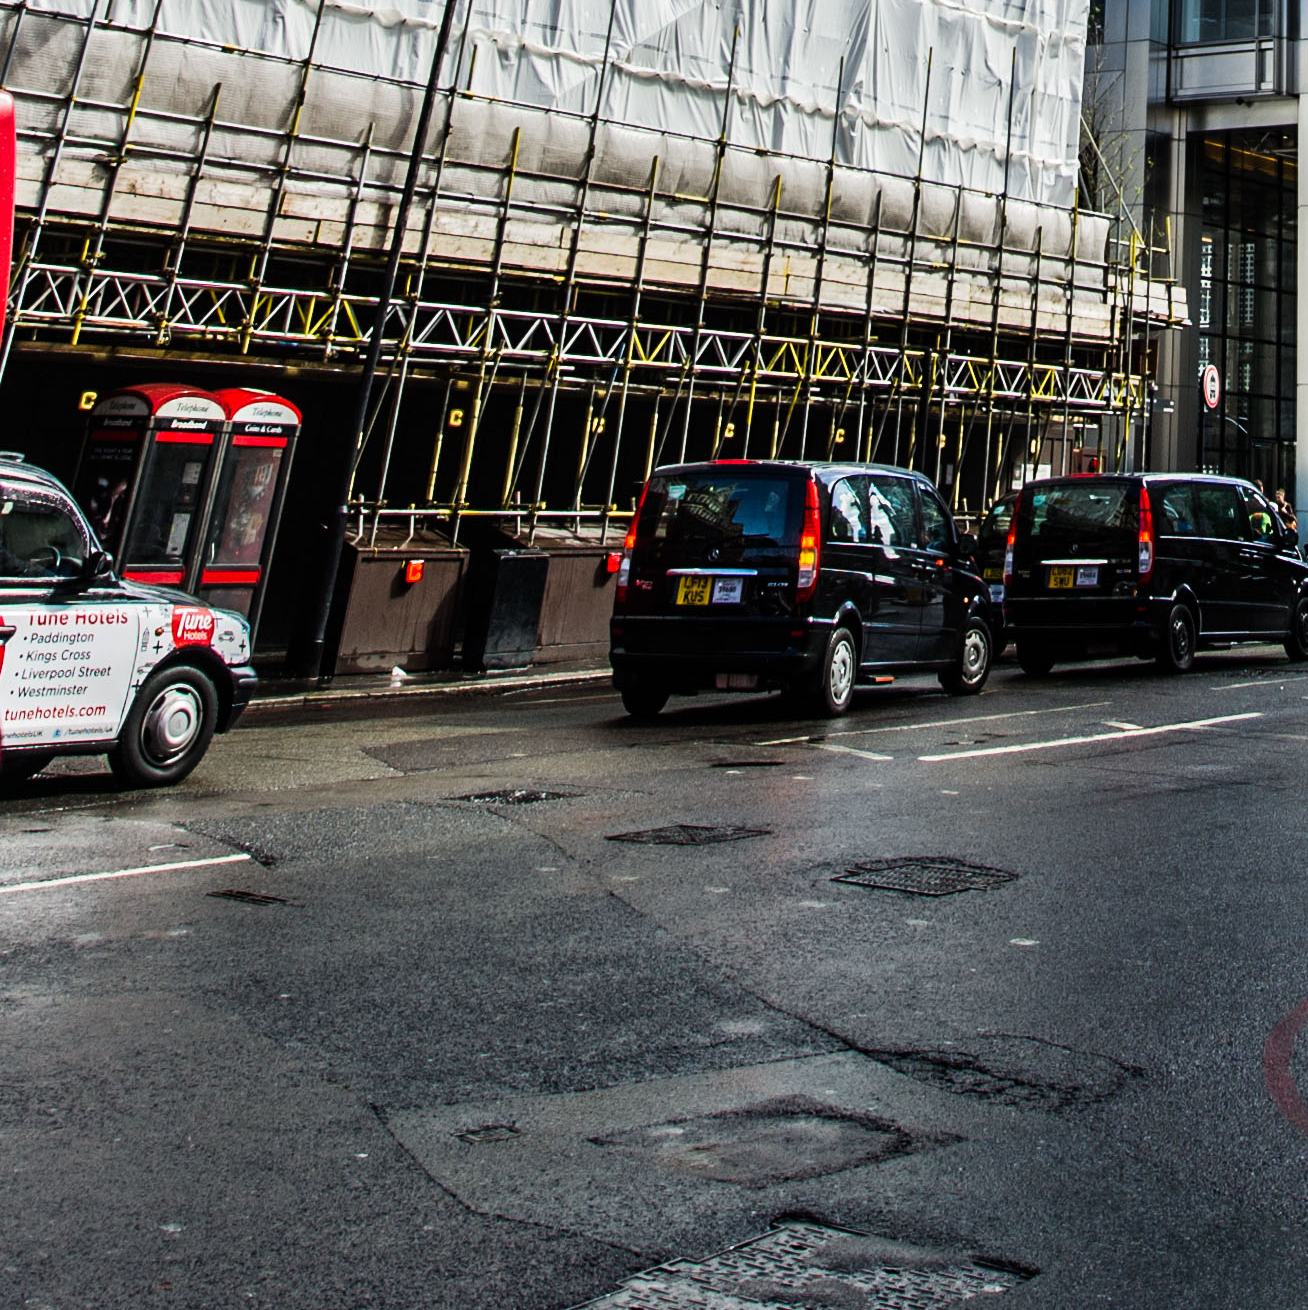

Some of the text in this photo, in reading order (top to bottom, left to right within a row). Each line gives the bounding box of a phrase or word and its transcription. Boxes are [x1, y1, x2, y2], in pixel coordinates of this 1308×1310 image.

[176, 402, 209, 414] Telephone
[252, 407, 283, 417] Telephone
[683, 590, 705, 603] KUS
[175, 608, 213, 638] Tune
[30, 632, 95, 645] Paddington
[26, 649, 91, 663] Kings Cross
[21, 666, 111, 680] Liverpool Street
[18, 685, 88, 697] Westminster
[5, 705, 106, 721] tunehotels.com
